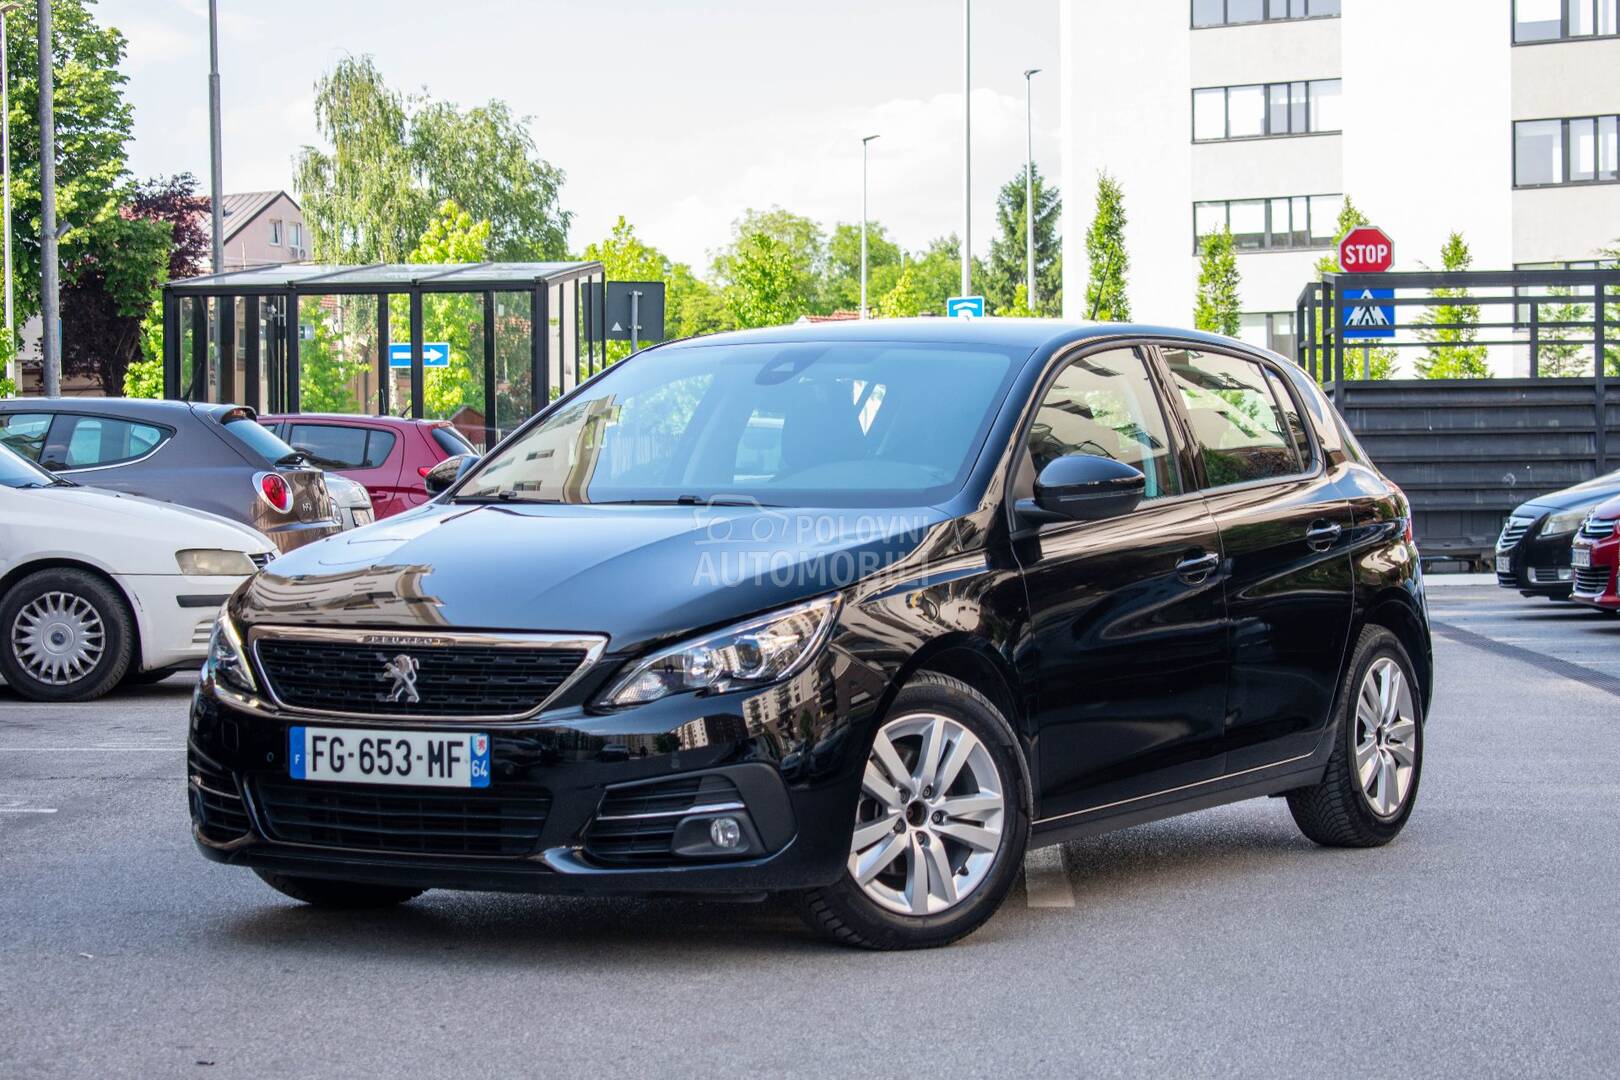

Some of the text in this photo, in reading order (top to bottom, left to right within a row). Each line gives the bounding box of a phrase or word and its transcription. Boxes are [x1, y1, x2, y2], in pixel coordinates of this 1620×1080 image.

[1345, 244, 1388, 264] STOP
[295, 754, 301, 765] F
[311, 735, 464, 778] FG-653-MF
[471, 759, 489, 778] 64
